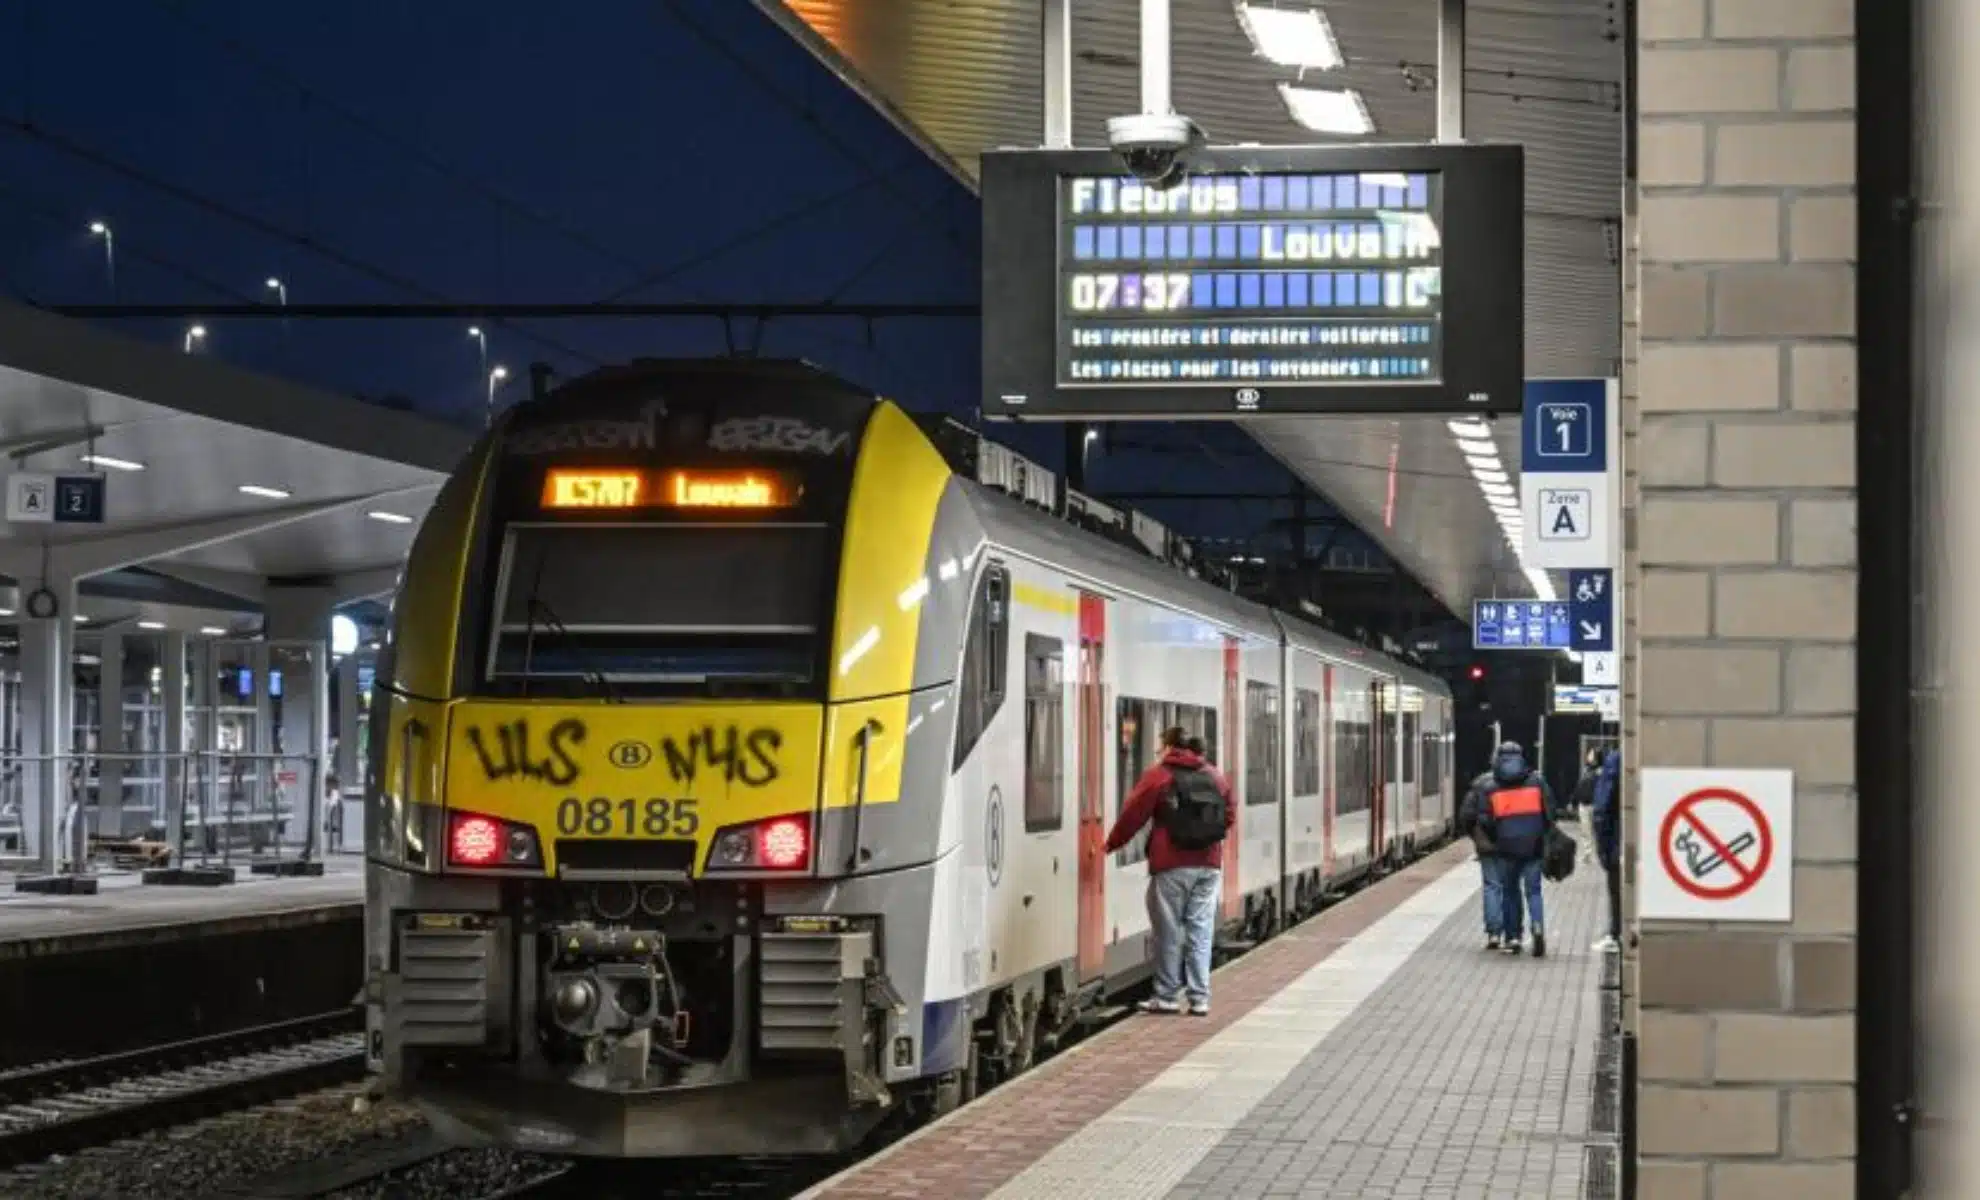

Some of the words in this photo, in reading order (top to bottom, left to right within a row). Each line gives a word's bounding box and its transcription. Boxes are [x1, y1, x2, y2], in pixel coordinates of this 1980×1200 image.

[1261, 225, 1429, 260] Louvain
[1072, 274, 1190, 310] 07:37
[1384, 272, 1429, 308] IC
[1071, 360, 1102, 378] Les
[1549, 407, 1578, 421] Voie
[1555, 422, 1570, 452] 1
[26, 493, 40, 508] A
[71, 496, 82, 512] 2
[1552, 505, 1576, 533] A
[556, 797, 700, 837] 08185
